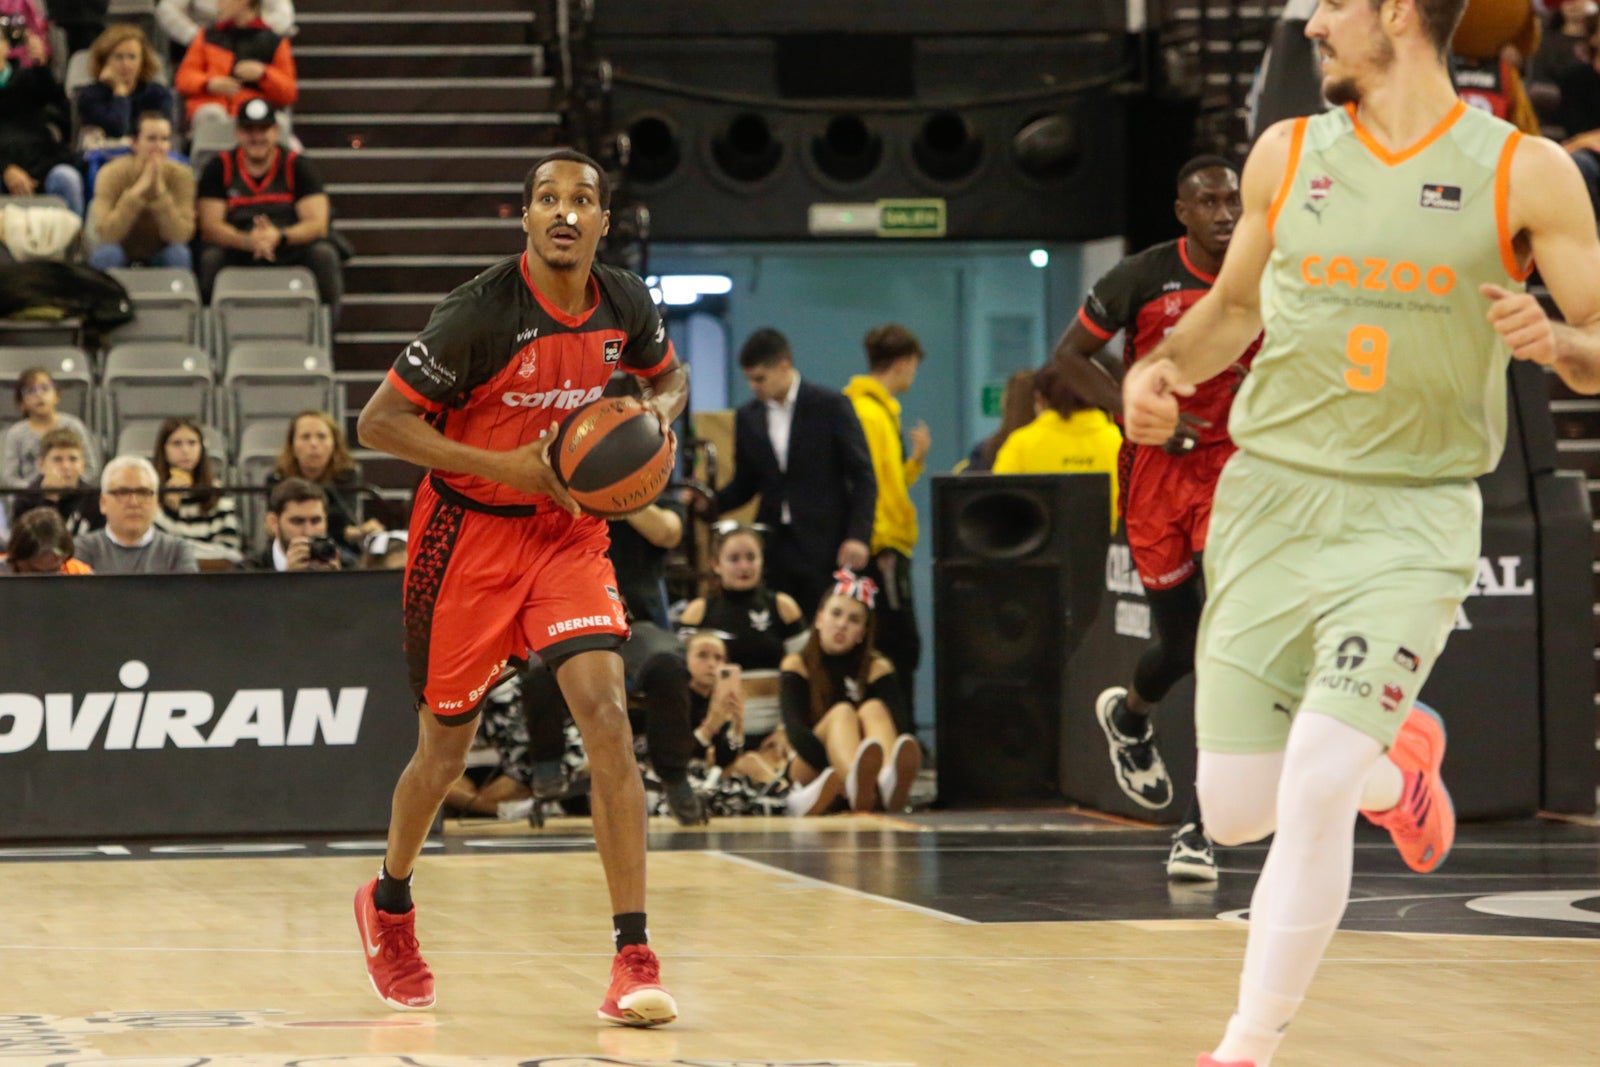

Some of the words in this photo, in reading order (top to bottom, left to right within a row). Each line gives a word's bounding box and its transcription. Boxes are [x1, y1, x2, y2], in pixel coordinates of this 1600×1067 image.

[1301, 255, 1457, 296] CAZOO
[1344, 325, 1388, 392] 9
[556, 615, 613, 633] BERNER
